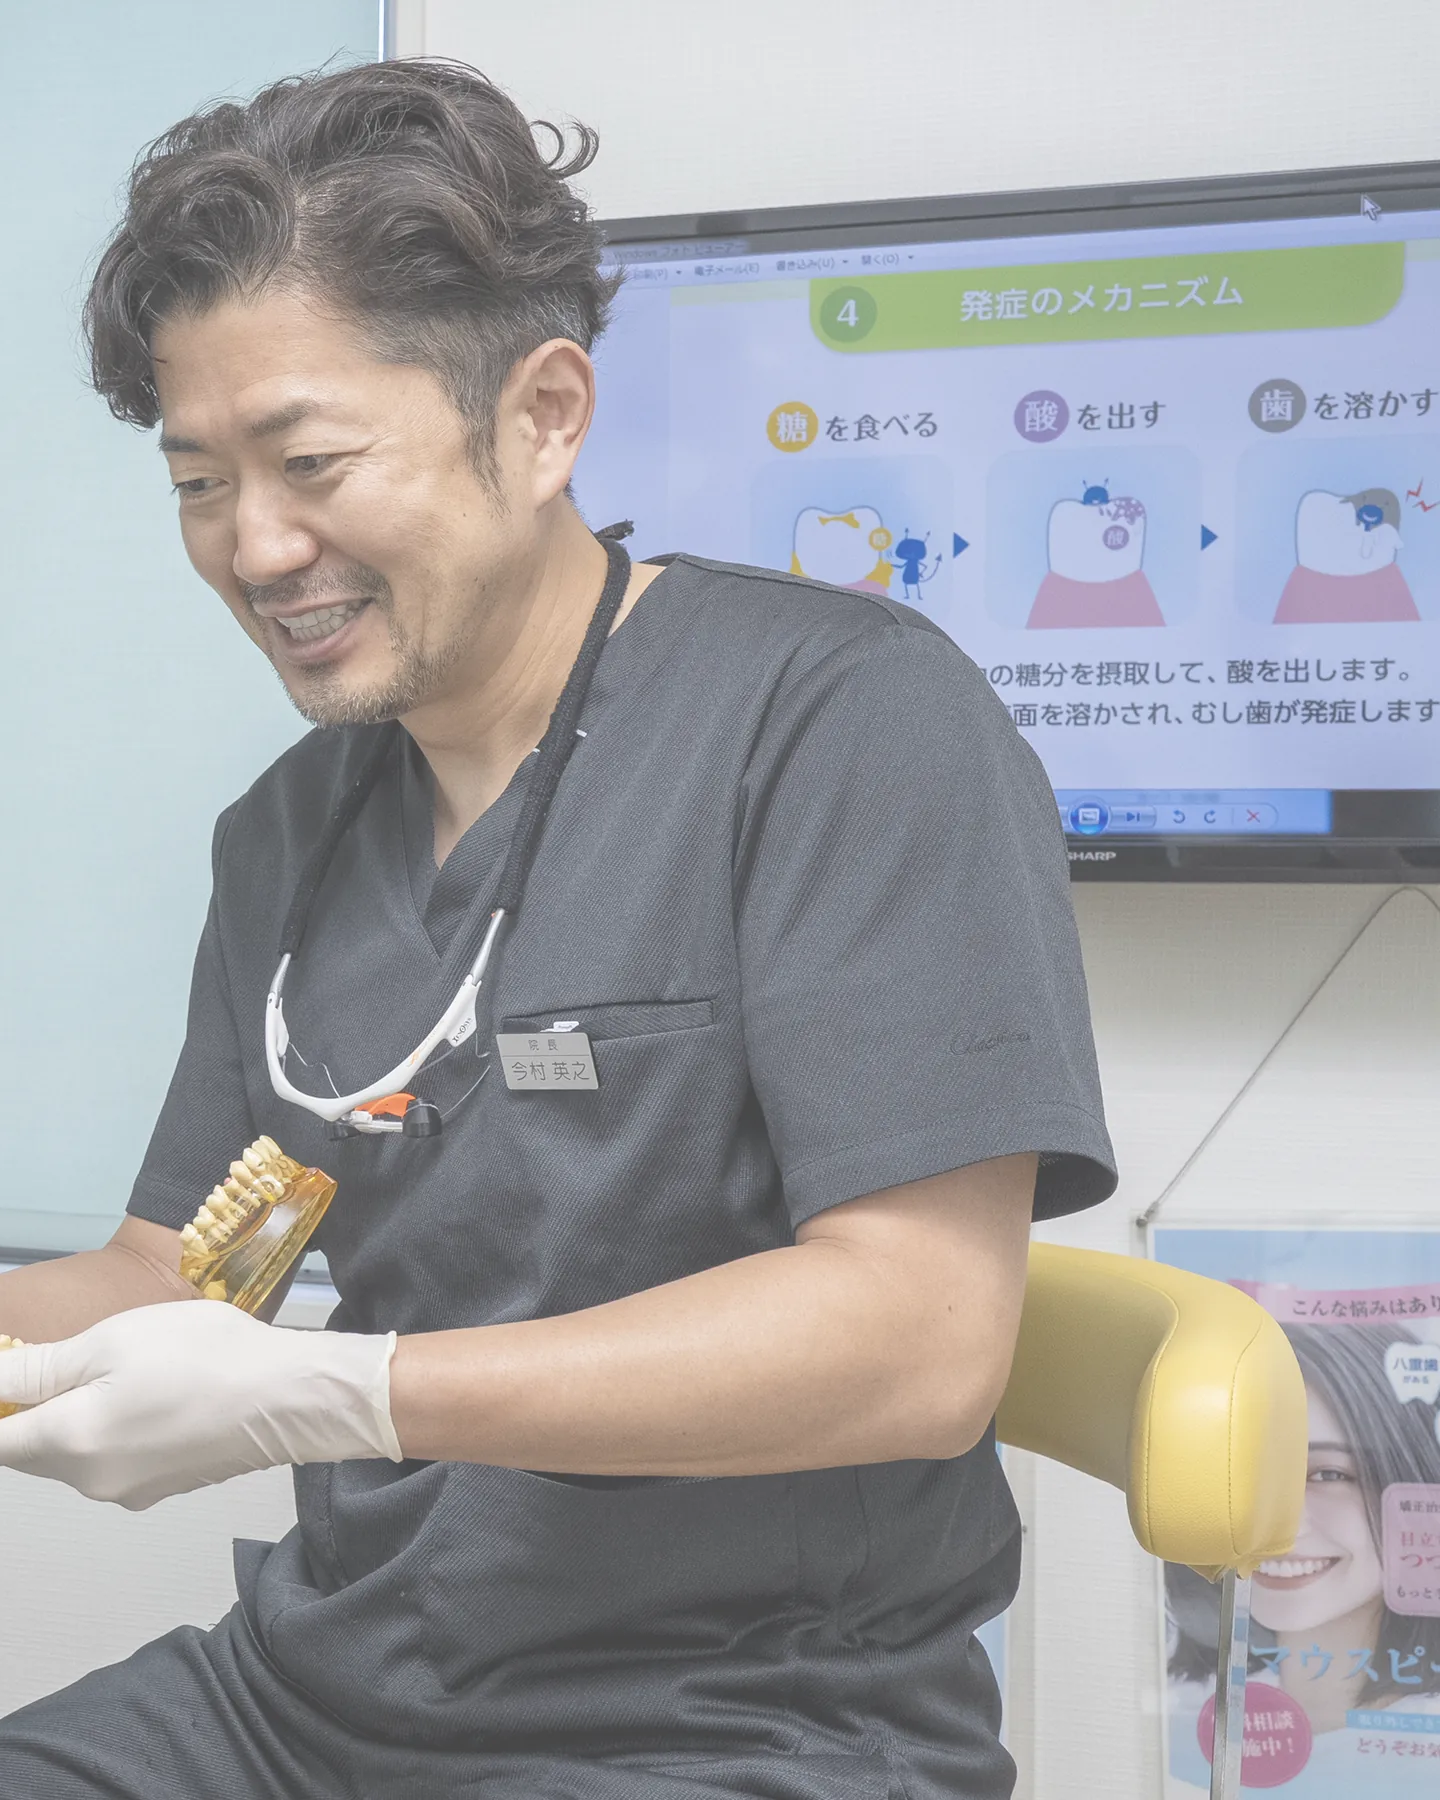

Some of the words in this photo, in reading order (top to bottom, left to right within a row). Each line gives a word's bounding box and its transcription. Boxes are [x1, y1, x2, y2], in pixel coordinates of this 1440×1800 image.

[836, 299, 859, 327] 4
[960, 275, 1244, 322] 発症のメカニズム
[981, 657, 1409, 687] の糖分を摂取して、酸を出します。
[1007, 698, 1440, 727] 面を溶かされ、むし歯が発症します
[511, 1061, 546, 1082] 今村
[551, 1061, 590, 1082] 英之
[1249, 1643, 1440, 1685] マウスピ
